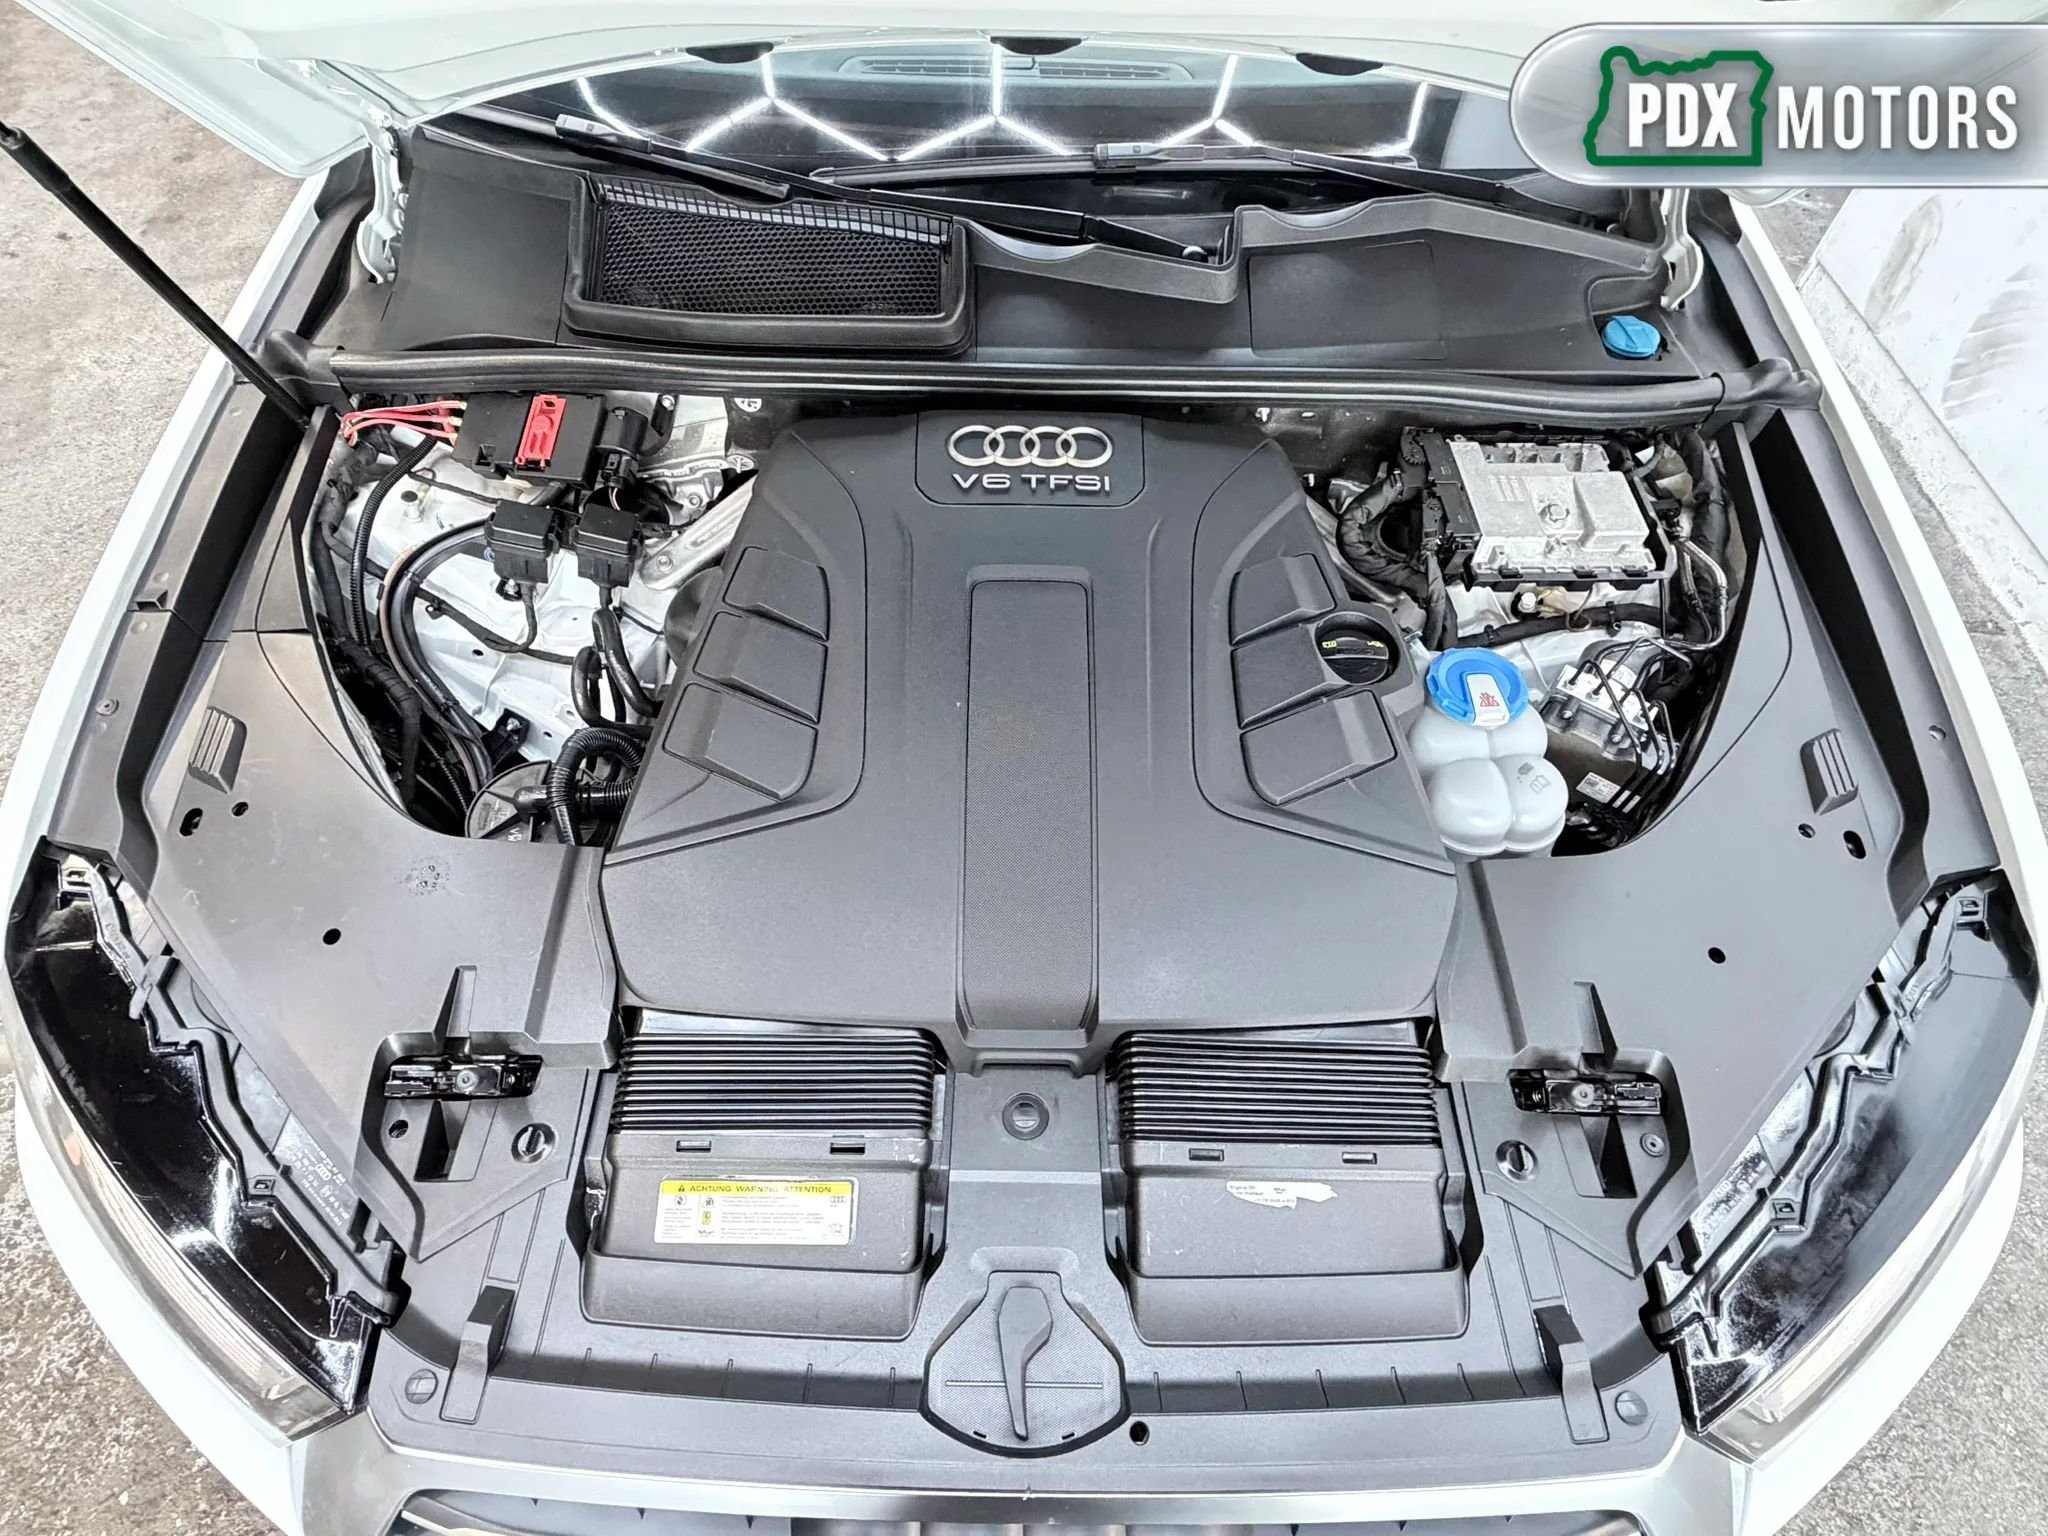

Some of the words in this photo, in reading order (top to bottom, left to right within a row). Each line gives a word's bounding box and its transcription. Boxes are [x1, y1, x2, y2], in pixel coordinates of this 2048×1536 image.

[953, 473, 1011, 489] V6
[1021, 474, 1110, 491] TFSI
[690, 1185, 732, 1193] ACHTUNG
[736, 1185, 779, 1193] WARNIN
[784, 1185, 832, 1193] ATTENTION
